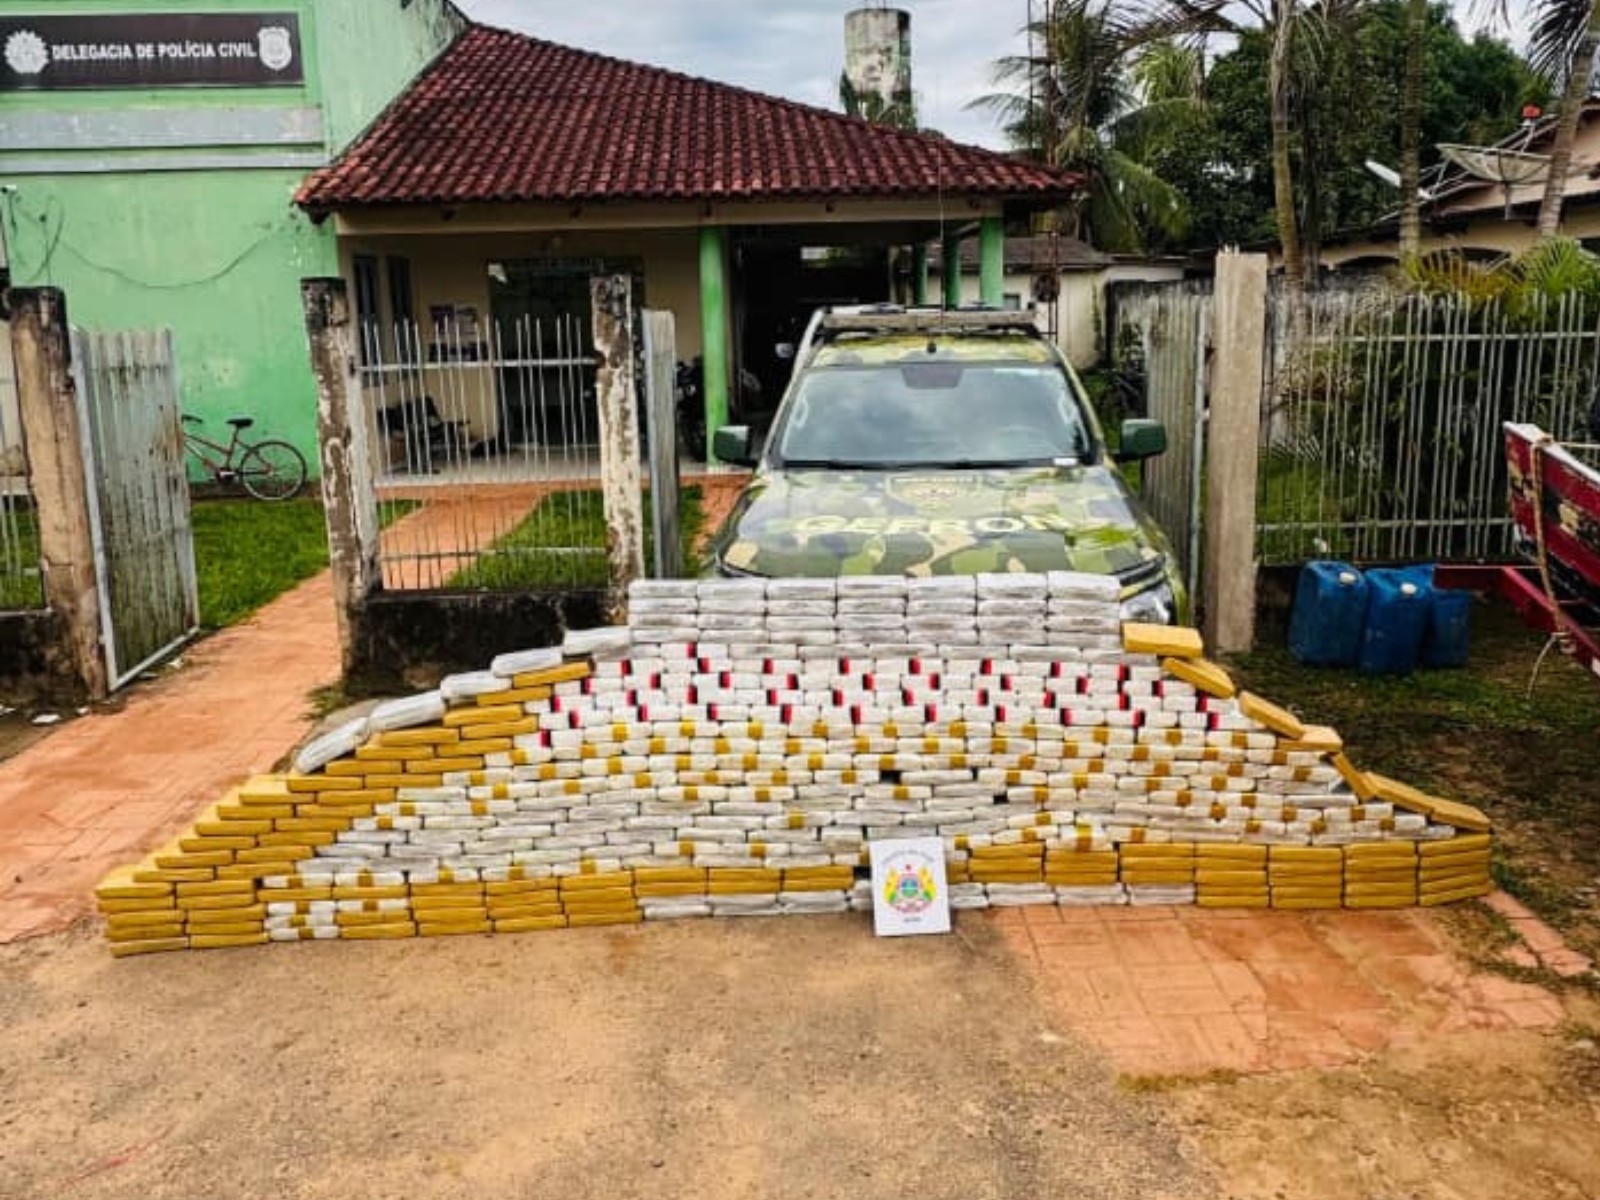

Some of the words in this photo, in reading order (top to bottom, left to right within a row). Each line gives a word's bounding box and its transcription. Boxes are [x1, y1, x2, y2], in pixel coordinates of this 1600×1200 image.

[52, 44, 132, 60] DELEGACIA
[136, 43, 155, 58] DE
[158, 40, 216, 58] POLÍCIA
[218, 42, 257, 57] CIVIL
